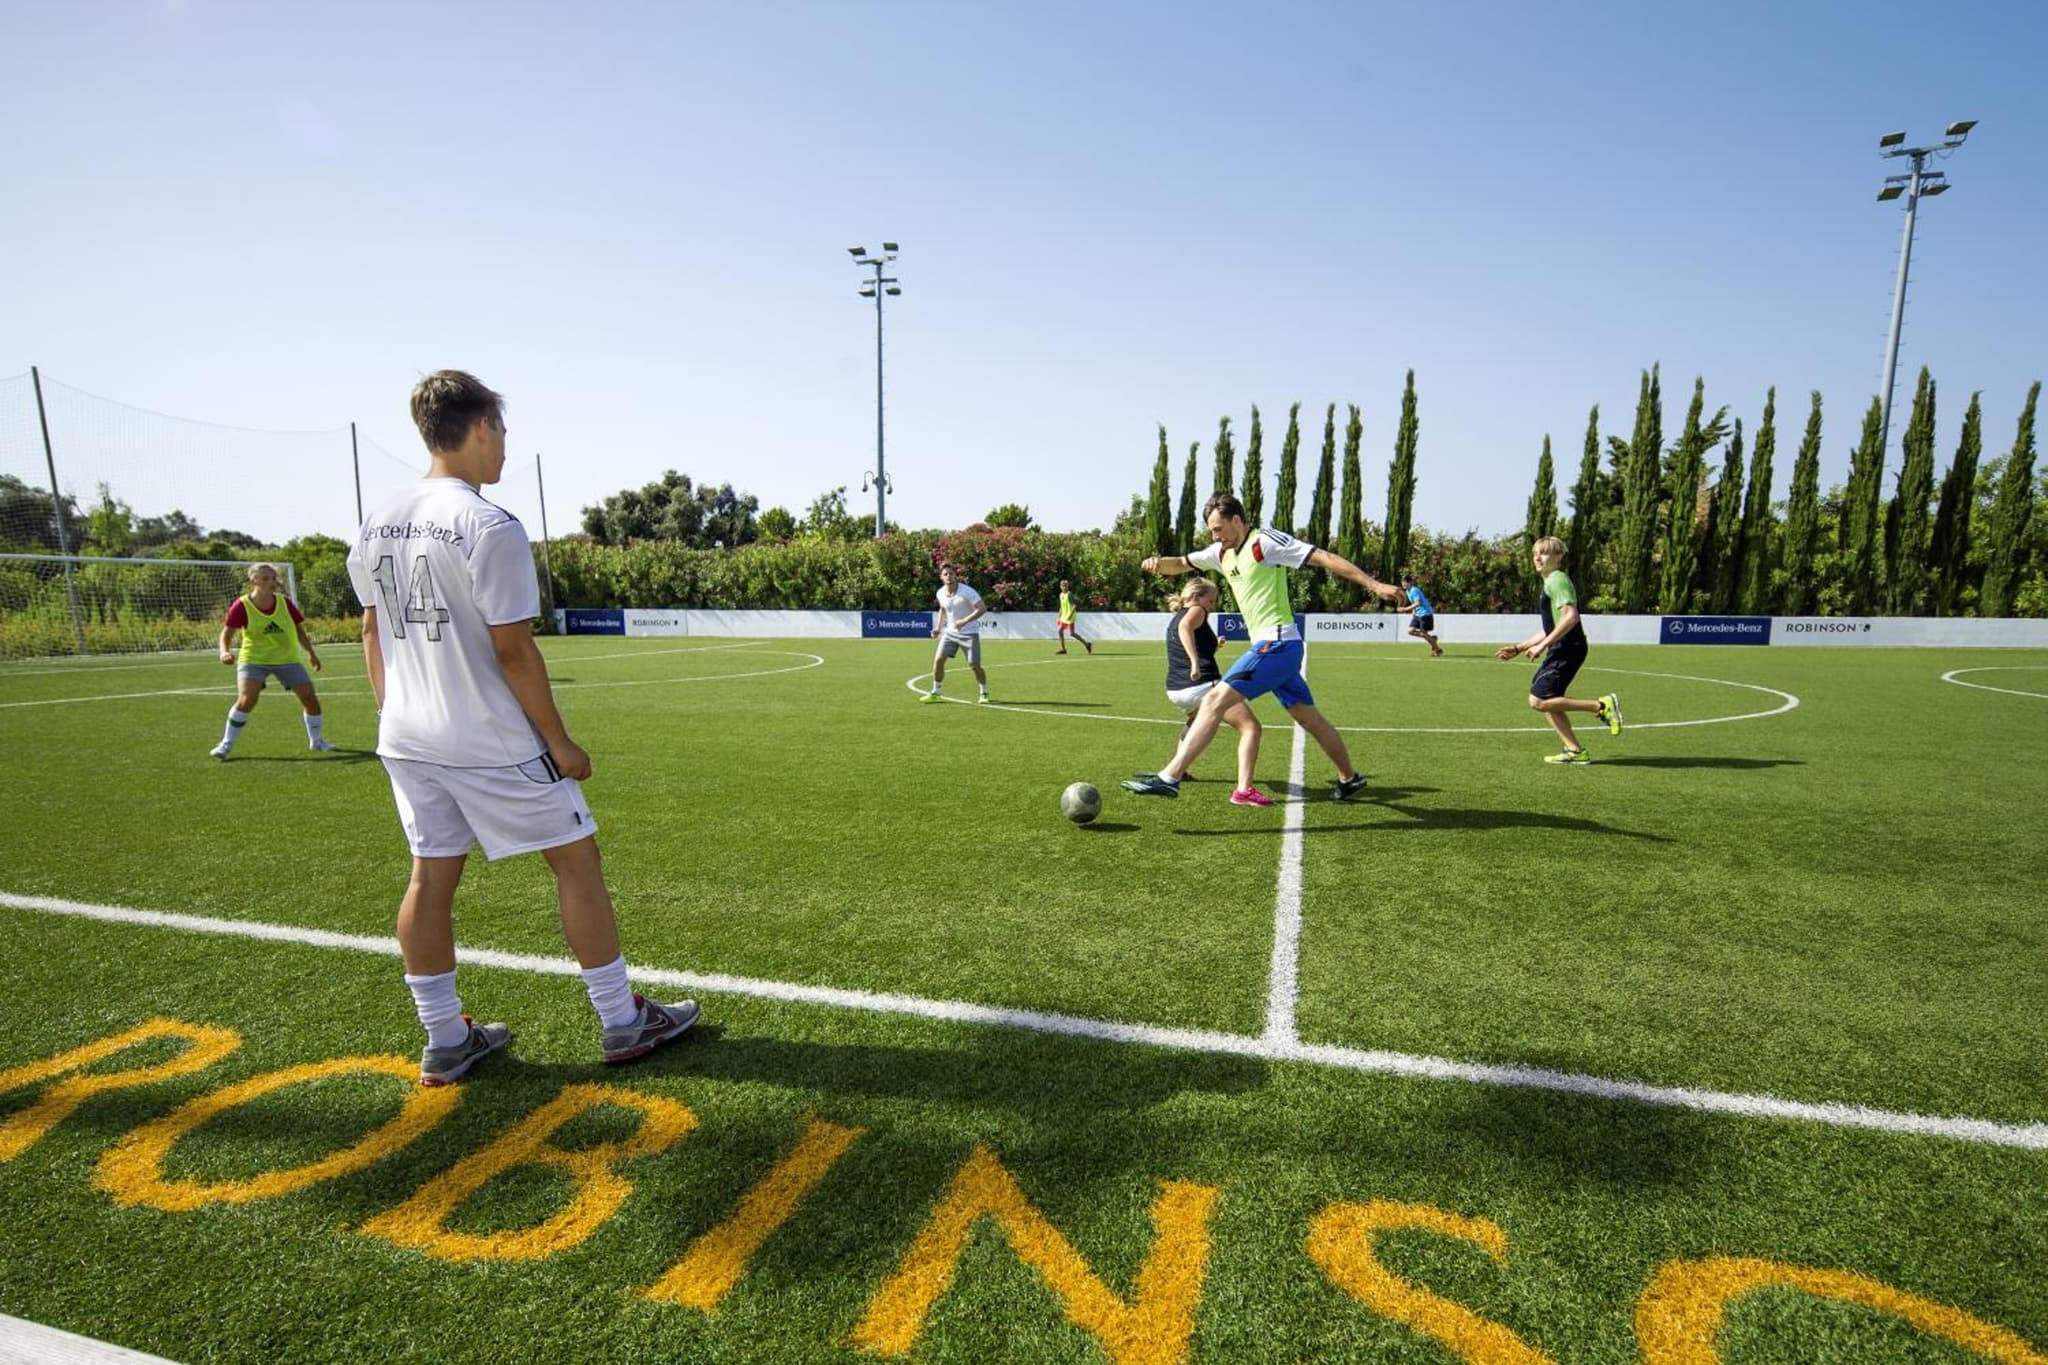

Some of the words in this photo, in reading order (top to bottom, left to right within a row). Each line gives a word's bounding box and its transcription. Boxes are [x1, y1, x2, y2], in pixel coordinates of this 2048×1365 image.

[372, 555, 450, 641] 14
[878, 620, 927, 629] Mercedes-Benz
[1316, 621, 1373, 631] ROBINSON
[1688, 622, 1762, 634] Mercedes-Benz
[1786, 623, 1856, 633] ROBINSON
